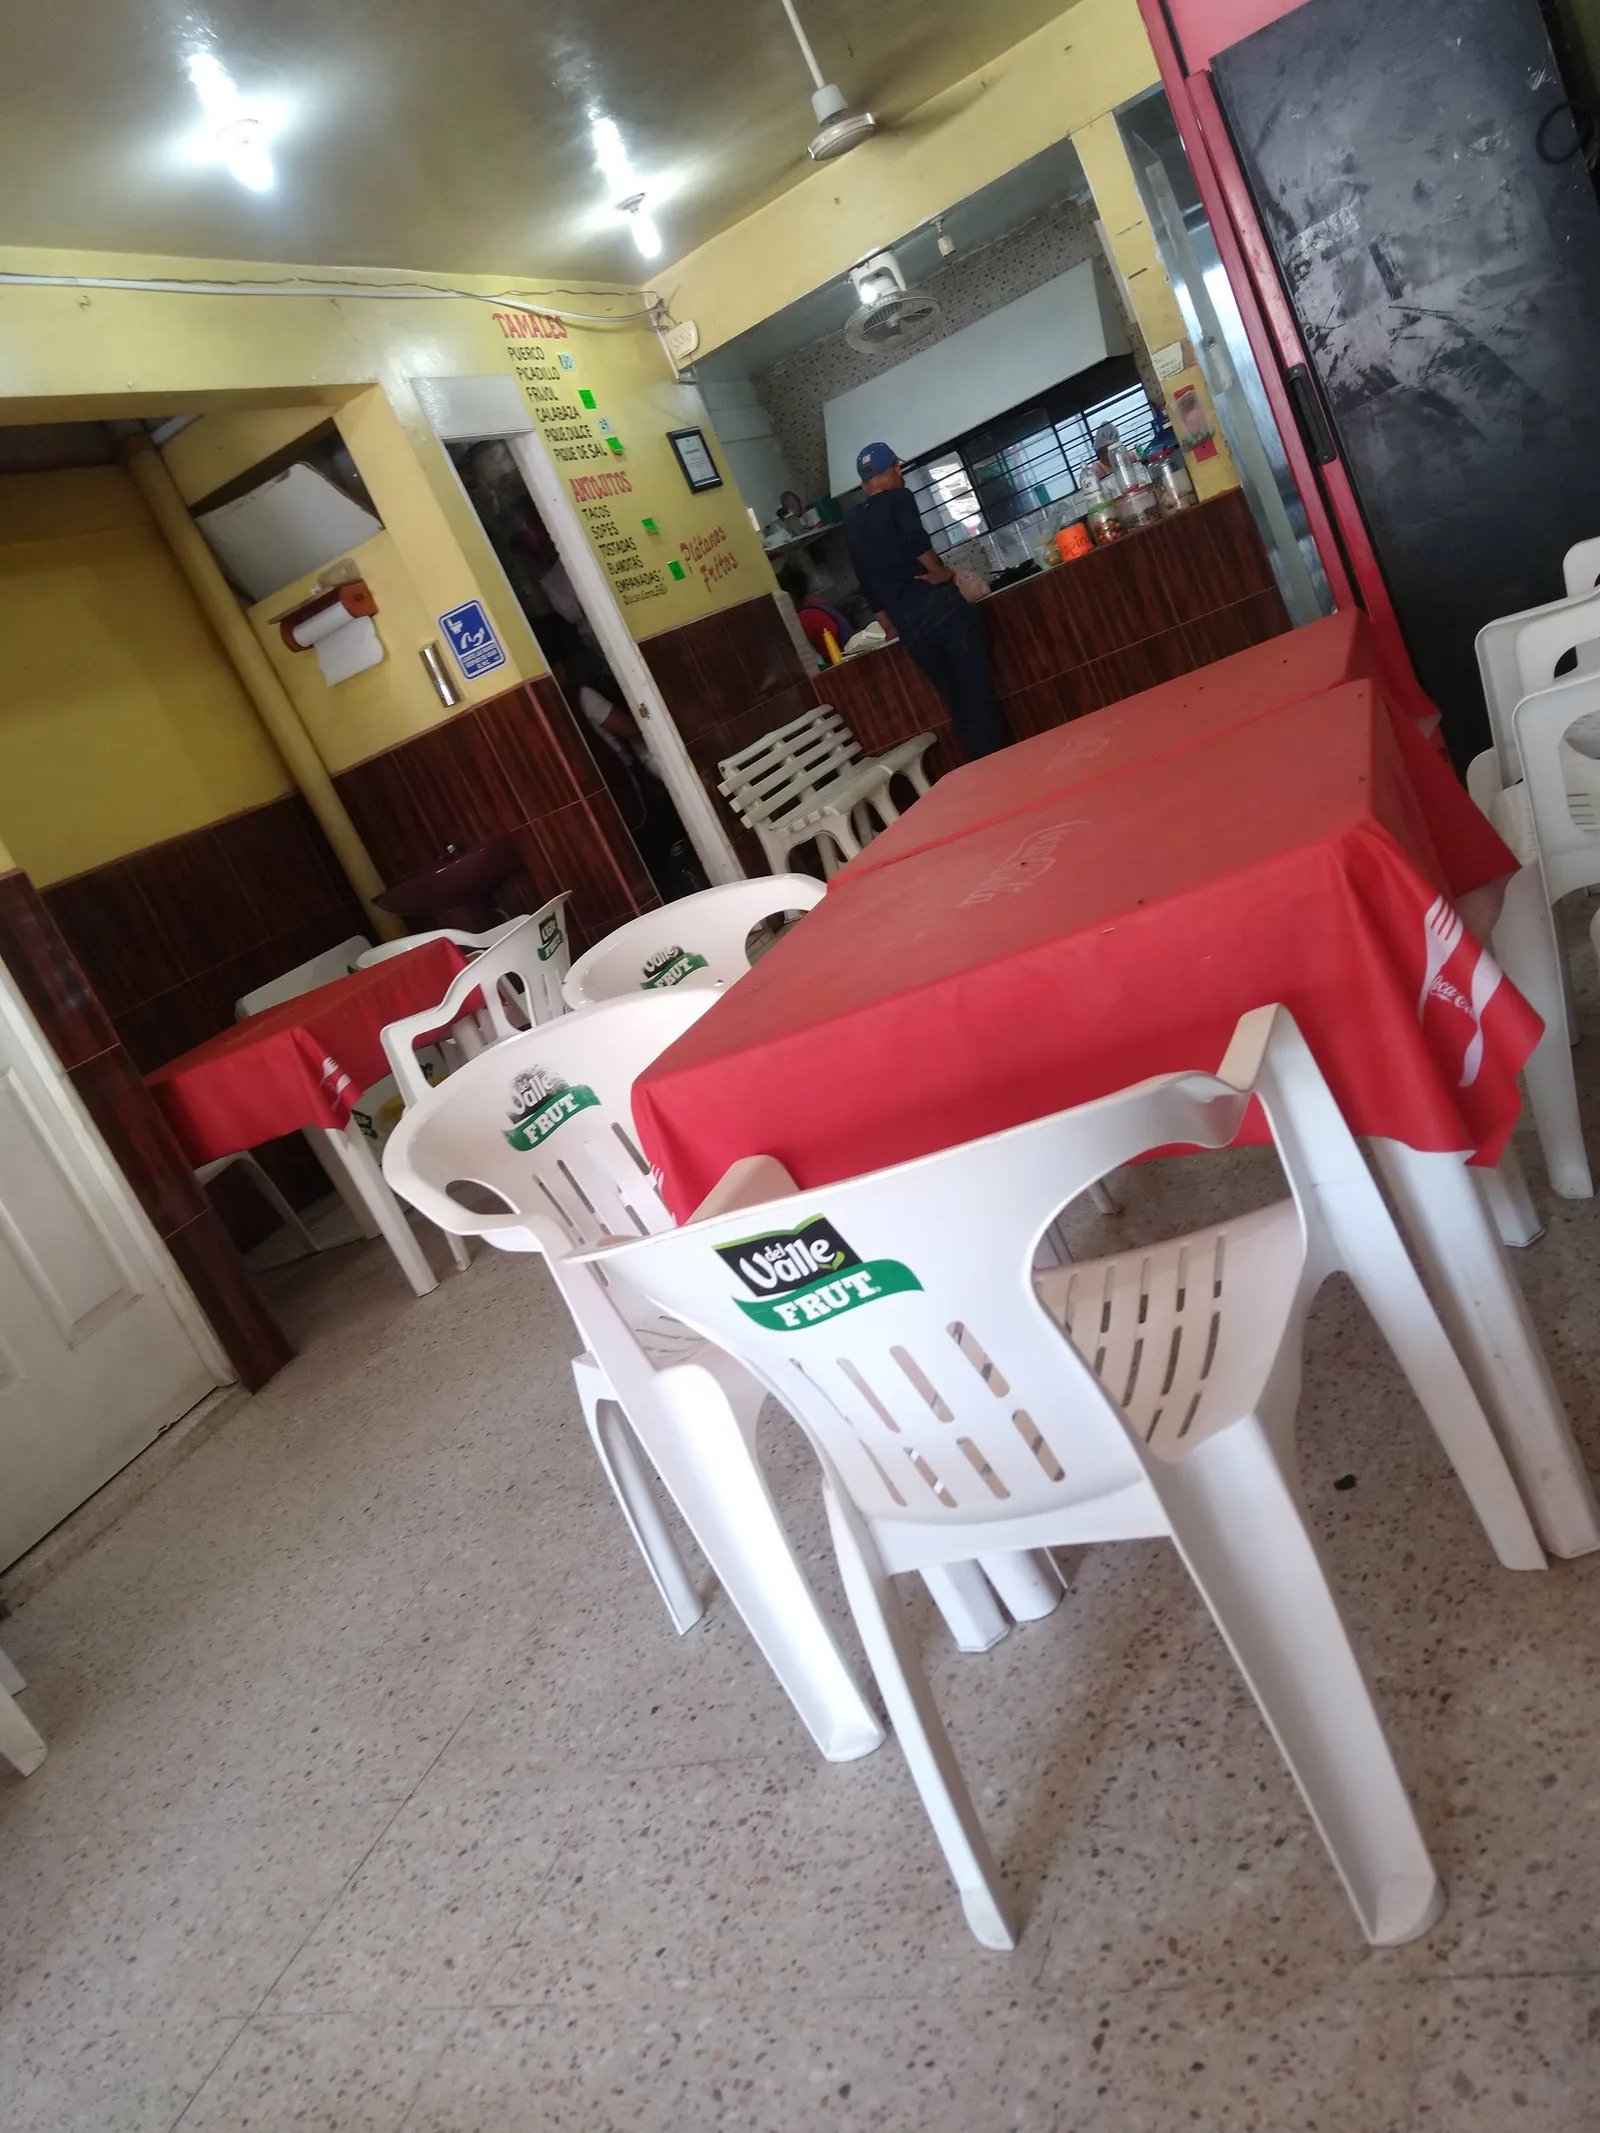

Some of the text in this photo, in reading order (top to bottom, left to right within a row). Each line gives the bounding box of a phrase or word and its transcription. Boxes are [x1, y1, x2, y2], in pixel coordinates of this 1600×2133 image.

[492, 313, 569, 339] TAMALES
[507, 346, 545, 361] PUERCO
[516, 366, 560, 381] PICADILLO
[535, 405, 582, 423] CALABAZA
[565, 424, 593, 440] DULCE
[576, 444, 590, 459] DE
[587, 442, 608, 458] SAL
[581, 504, 611, 521] TACOS
[591, 521, 619, 539] SOPES
[598, 537, 637, 558] TOSTADAS
[522, 1093, 580, 1144] FRUT
[764, 1242, 787, 1262] del
[739, 1238, 836, 1289] Valle
[772, 1269, 873, 1328] FRUT
